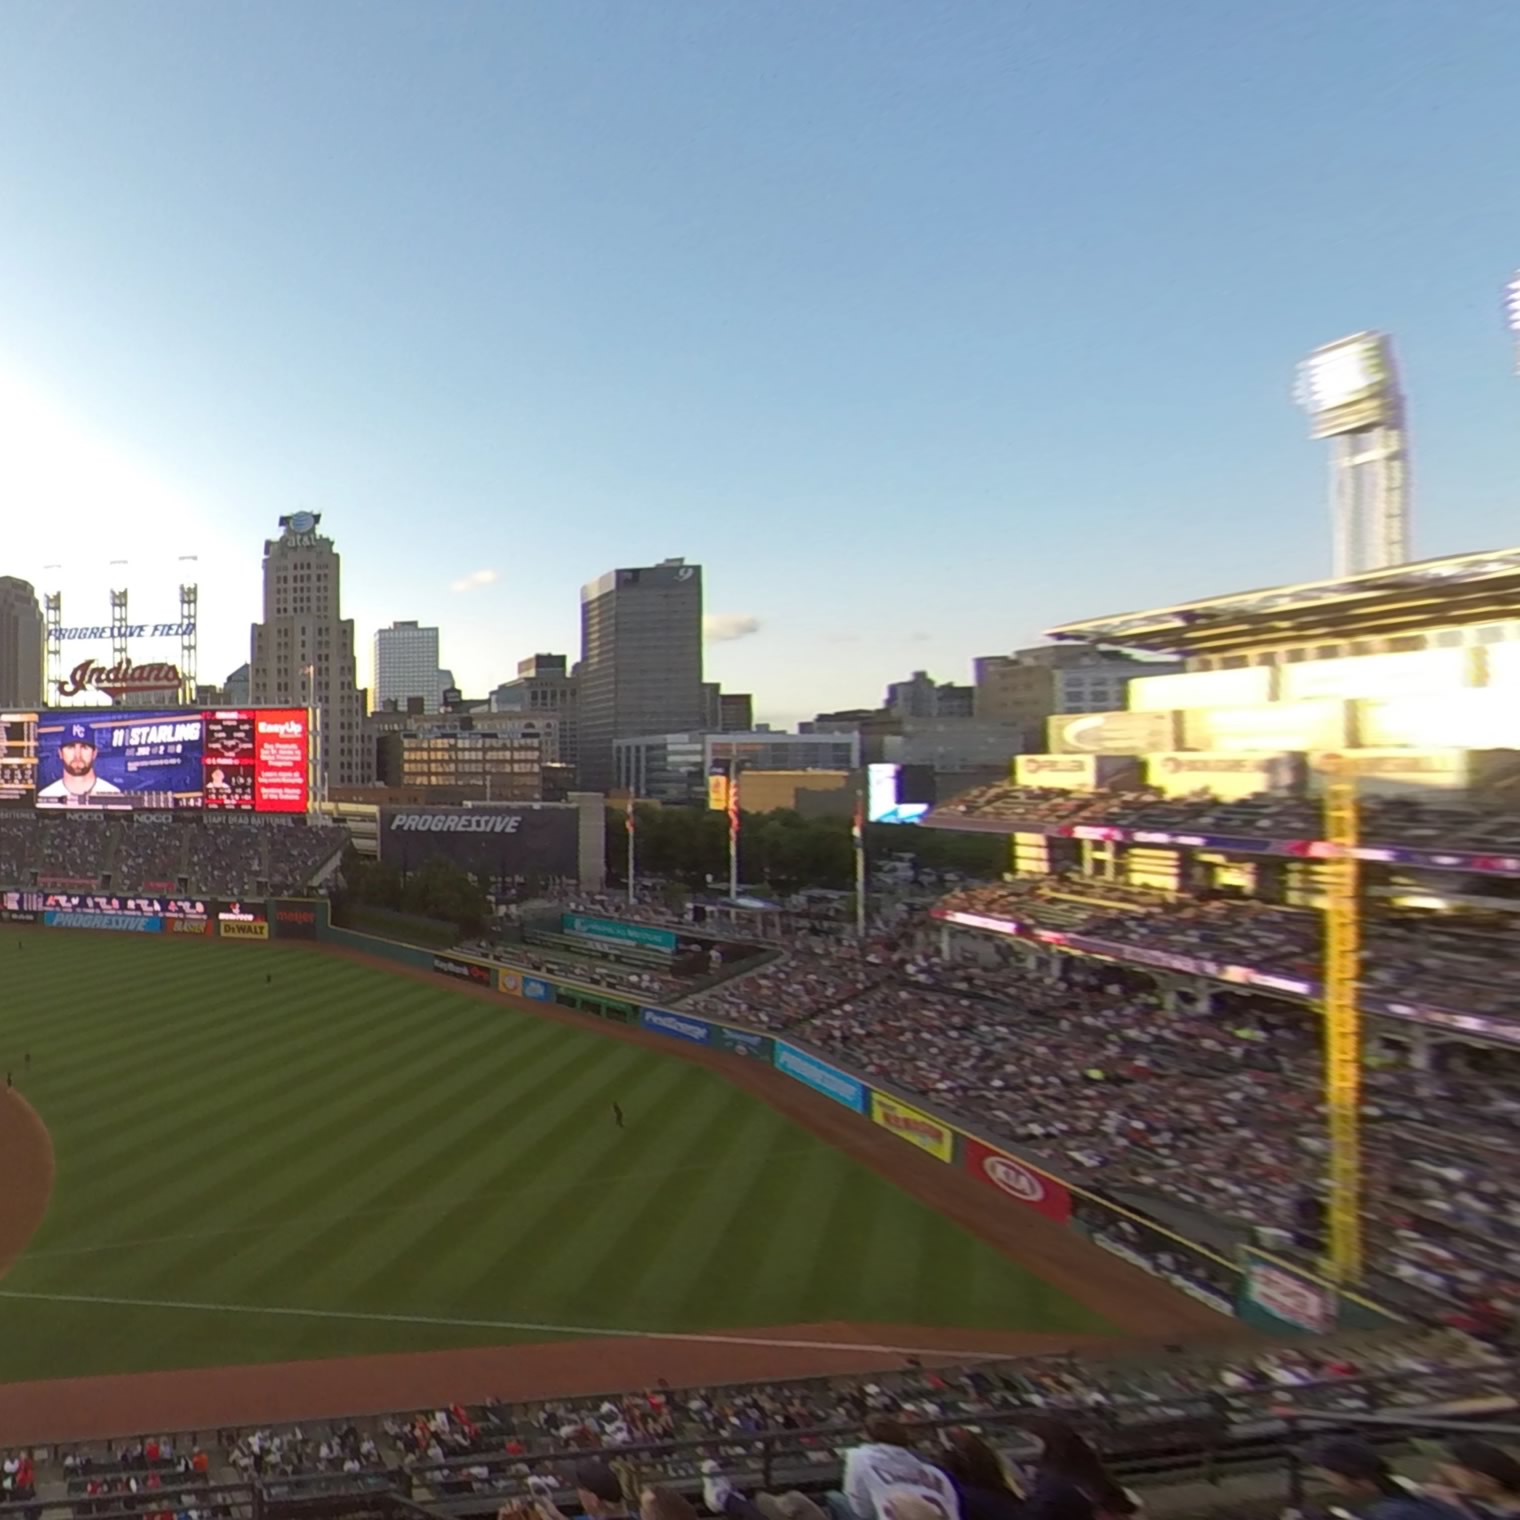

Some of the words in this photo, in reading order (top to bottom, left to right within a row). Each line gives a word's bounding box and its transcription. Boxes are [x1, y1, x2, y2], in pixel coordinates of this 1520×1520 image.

[48, 625, 147, 640] PROGRESSIVE
[151, 622, 195, 637] FIELD
[58, 657, 183, 699] Indians
[129, 722, 201, 746] STARLING
[258, 721, 302, 734] EasyUp
[133, 814, 172, 824] NOCO
[390, 814, 522, 833] PROGRESSIVE
[52, 912, 150, 931] PROGRESSIVE
